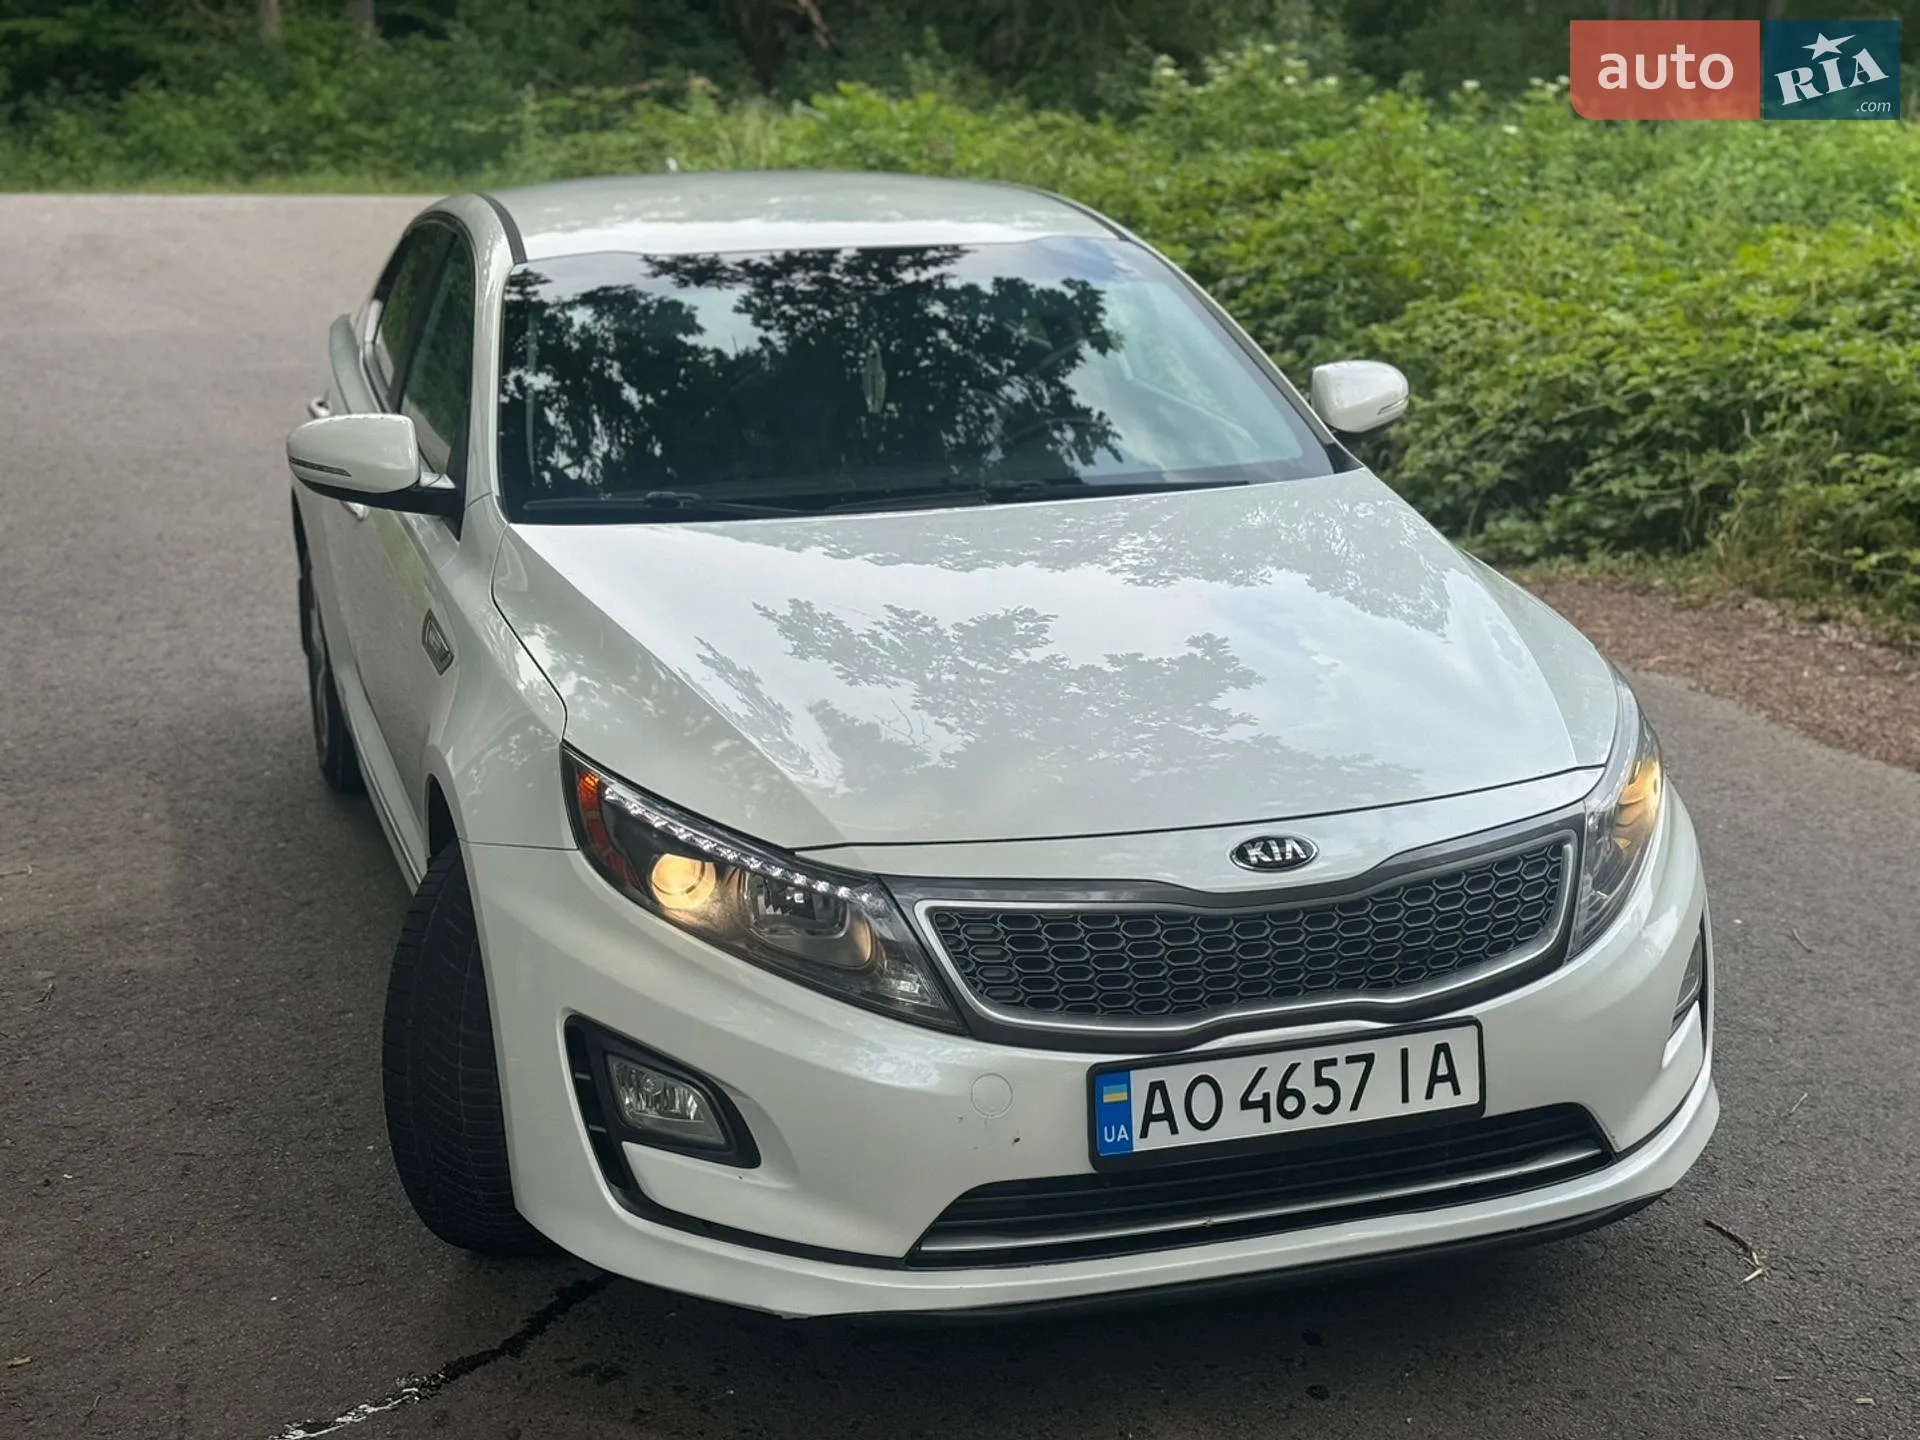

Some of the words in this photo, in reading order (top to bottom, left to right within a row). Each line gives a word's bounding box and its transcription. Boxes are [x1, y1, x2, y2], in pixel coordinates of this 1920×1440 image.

[1243, 839, 1307, 864] KIA
[1138, 1073, 1224, 1140] AO
[1239, 1051, 1376, 1124] 4657
[1400, 1042, 1462, 1104] IA
[1103, 1125, 1129, 1144] UA
